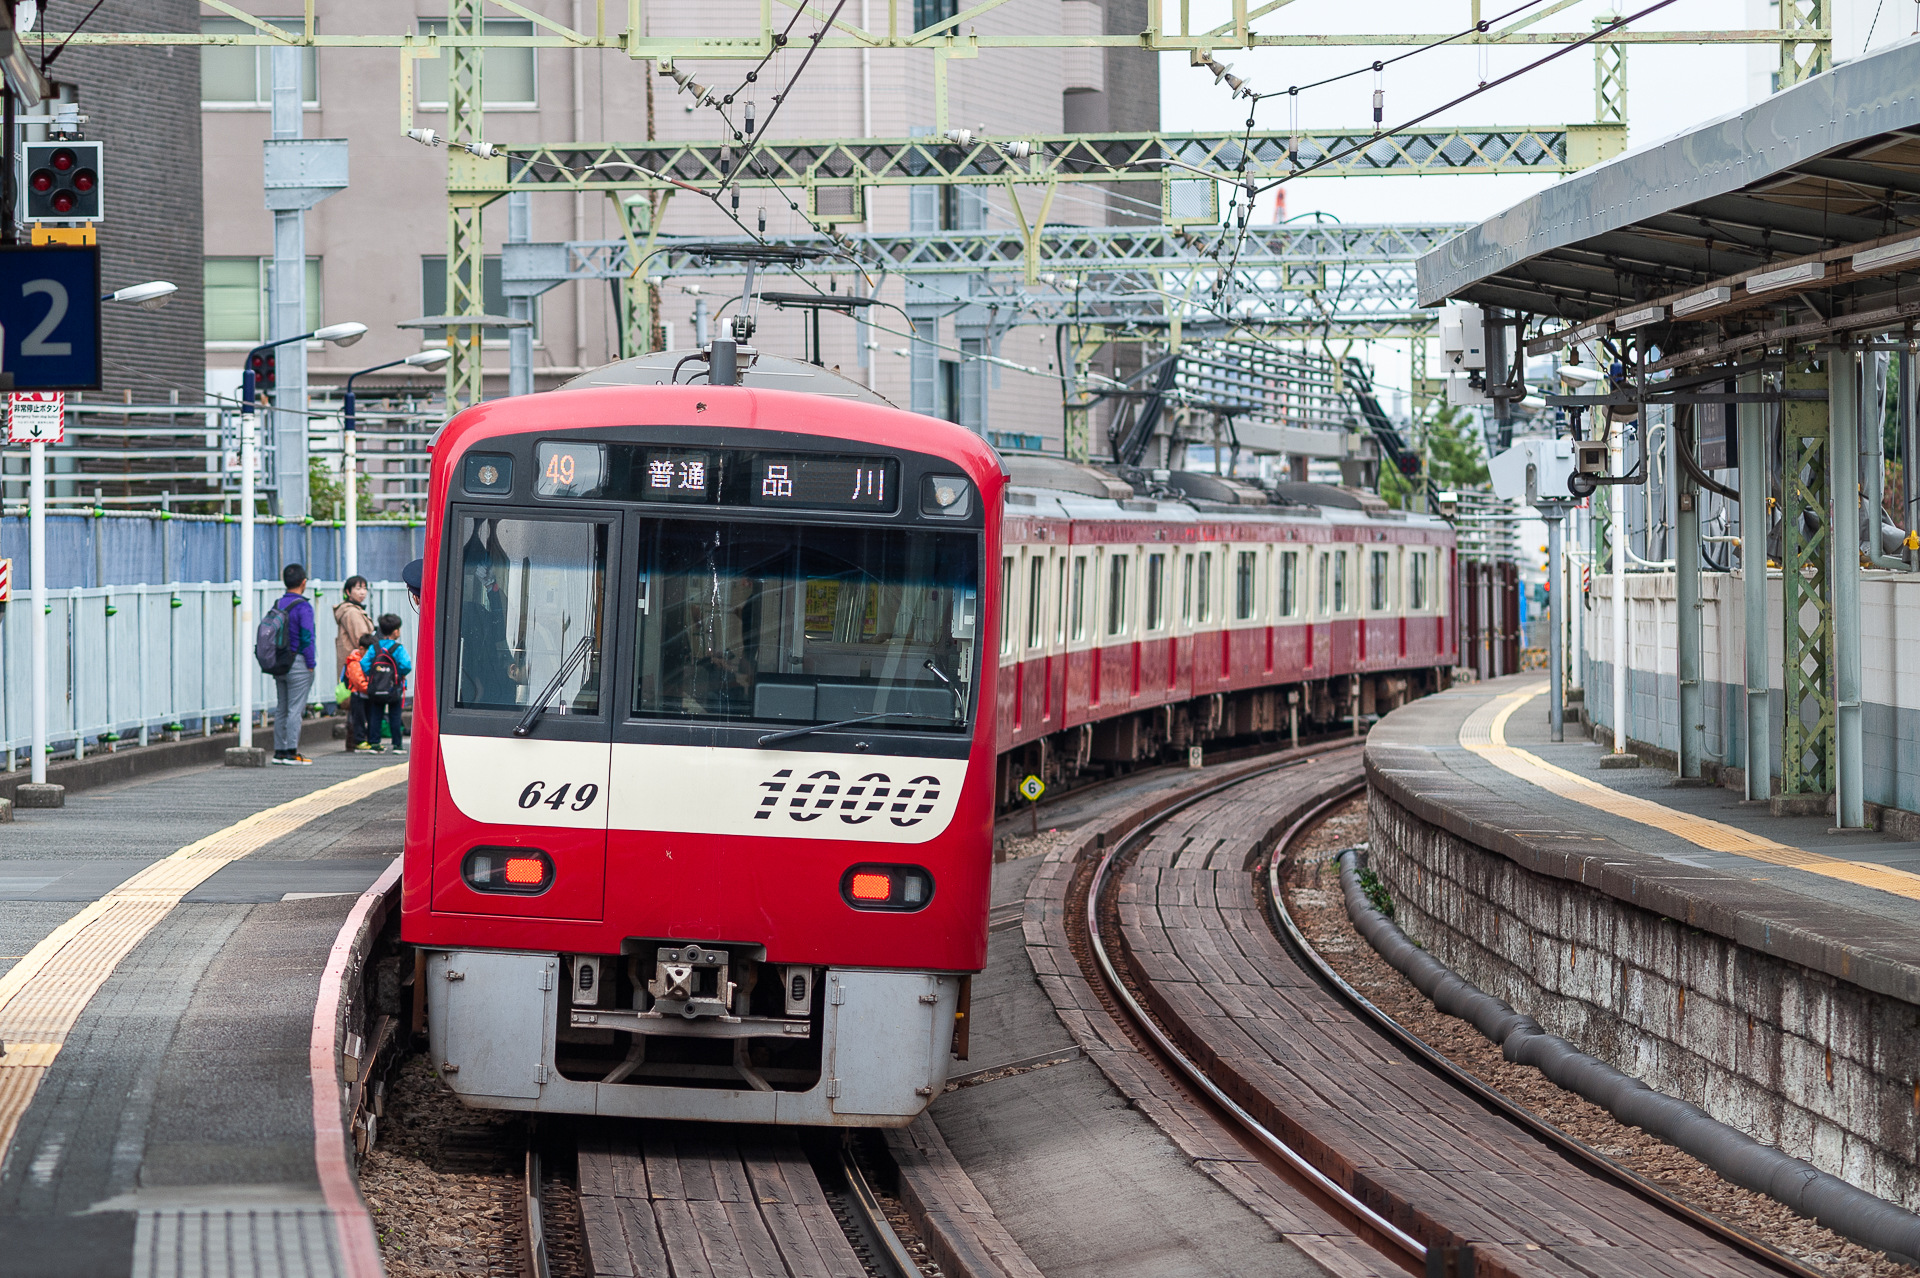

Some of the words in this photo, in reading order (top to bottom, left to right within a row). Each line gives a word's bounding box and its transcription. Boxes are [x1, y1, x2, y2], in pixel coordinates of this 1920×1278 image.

[20, 278, 72, 356] 2
[14, 404, 59, 412] 非常停止ボタン
[546, 454, 575, 485] 49
[648, 459, 705, 490] 普通
[762, 465, 884, 500] 品川
[518, 780, 599, 812] 649
[754, 769, 941, 827] 1000
[1028, 782, 1036, 794] 6
